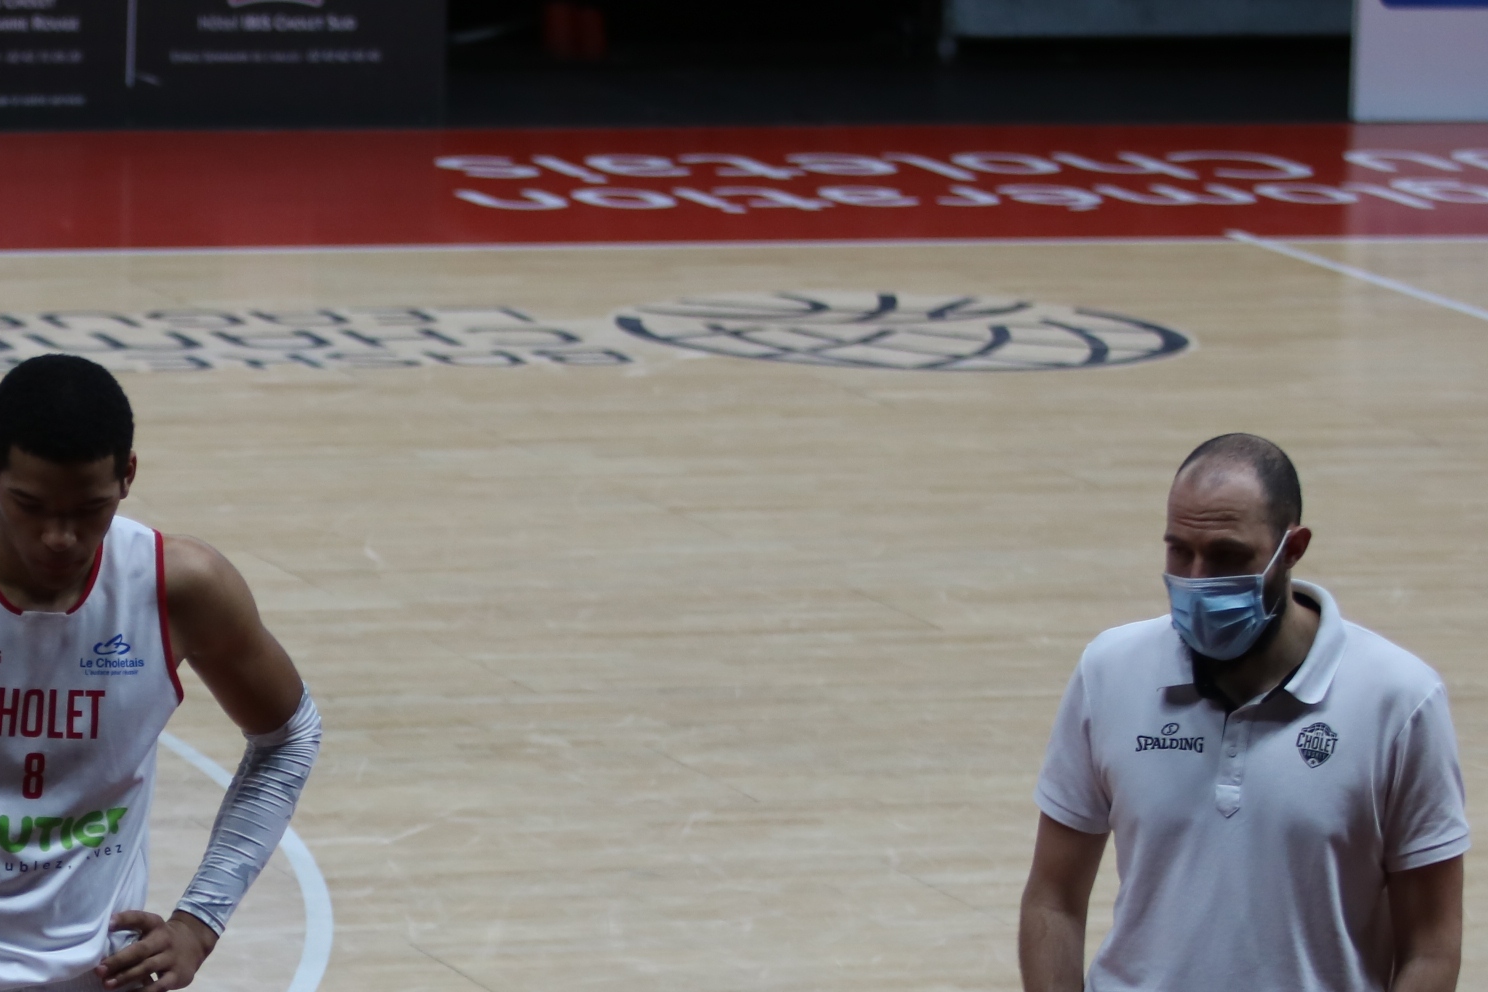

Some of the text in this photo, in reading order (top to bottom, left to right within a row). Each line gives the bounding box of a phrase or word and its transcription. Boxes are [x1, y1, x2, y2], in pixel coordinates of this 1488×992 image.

[433, 150, 1314, 184] Choletais
[80, 657, 145, 669] Le Choletais
[1135, 735, 1205, 753] SPALDING
[1296, 732, 1338, 754] CHOLET
[22, 752, 45, 800] 8
